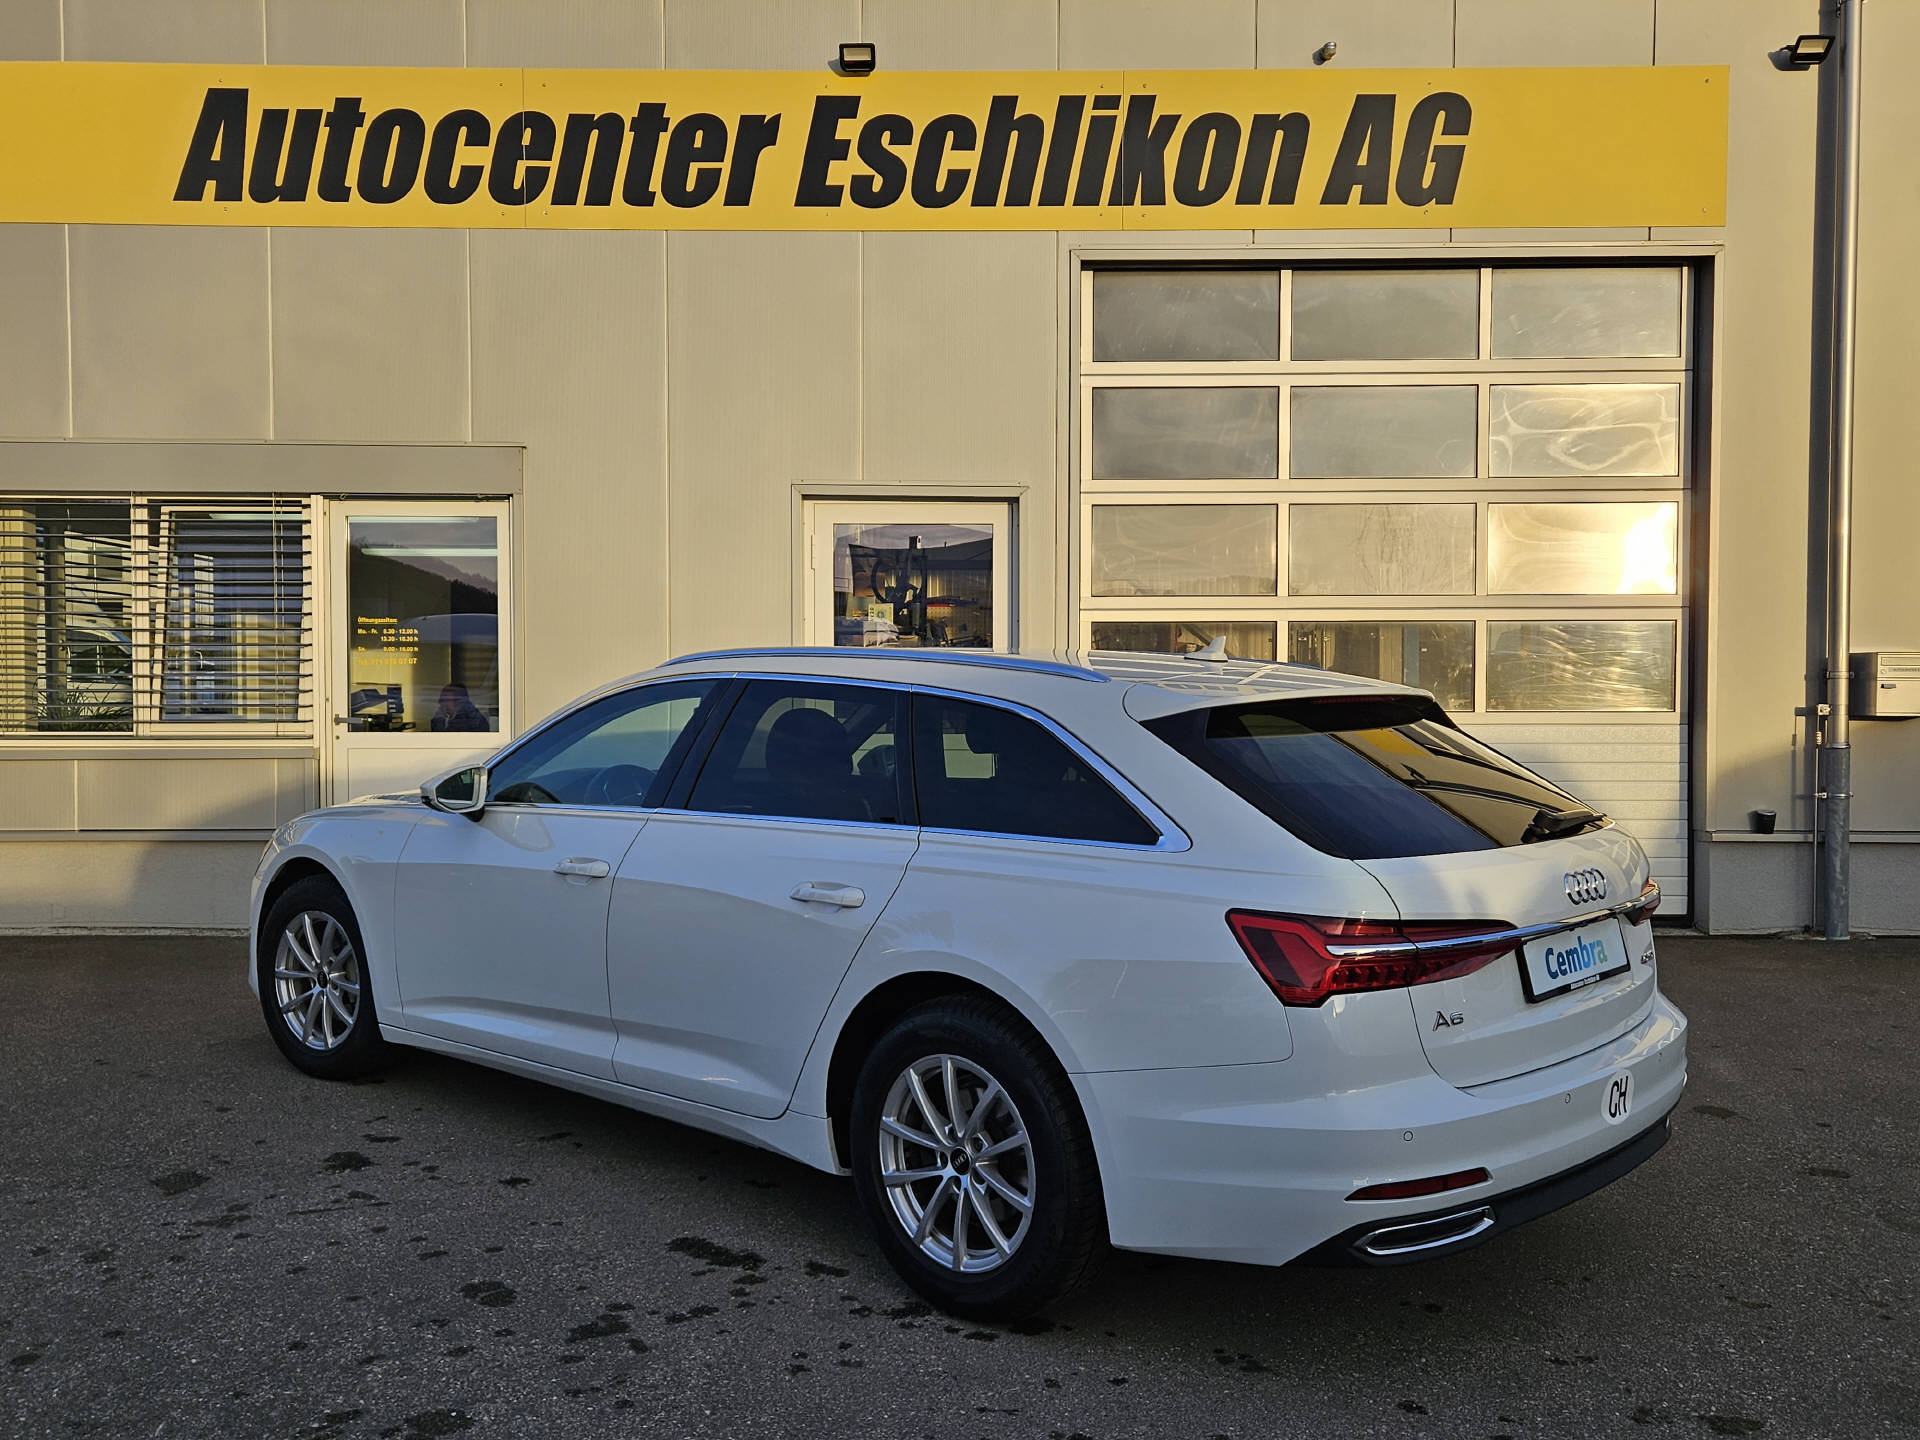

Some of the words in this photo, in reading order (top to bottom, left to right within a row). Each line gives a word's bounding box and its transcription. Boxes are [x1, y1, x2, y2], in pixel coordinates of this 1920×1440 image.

[173, 88, 782, 208] Autocenter
[794, 94, 1311, 209] Eschlikon
[1320, 91, 1472, 207] AG
[1545, 935, 1608, 980] Cembra
[1432, 1010, 1464, 1031] A6
[1608, 1075, 1629, 1118] CH
